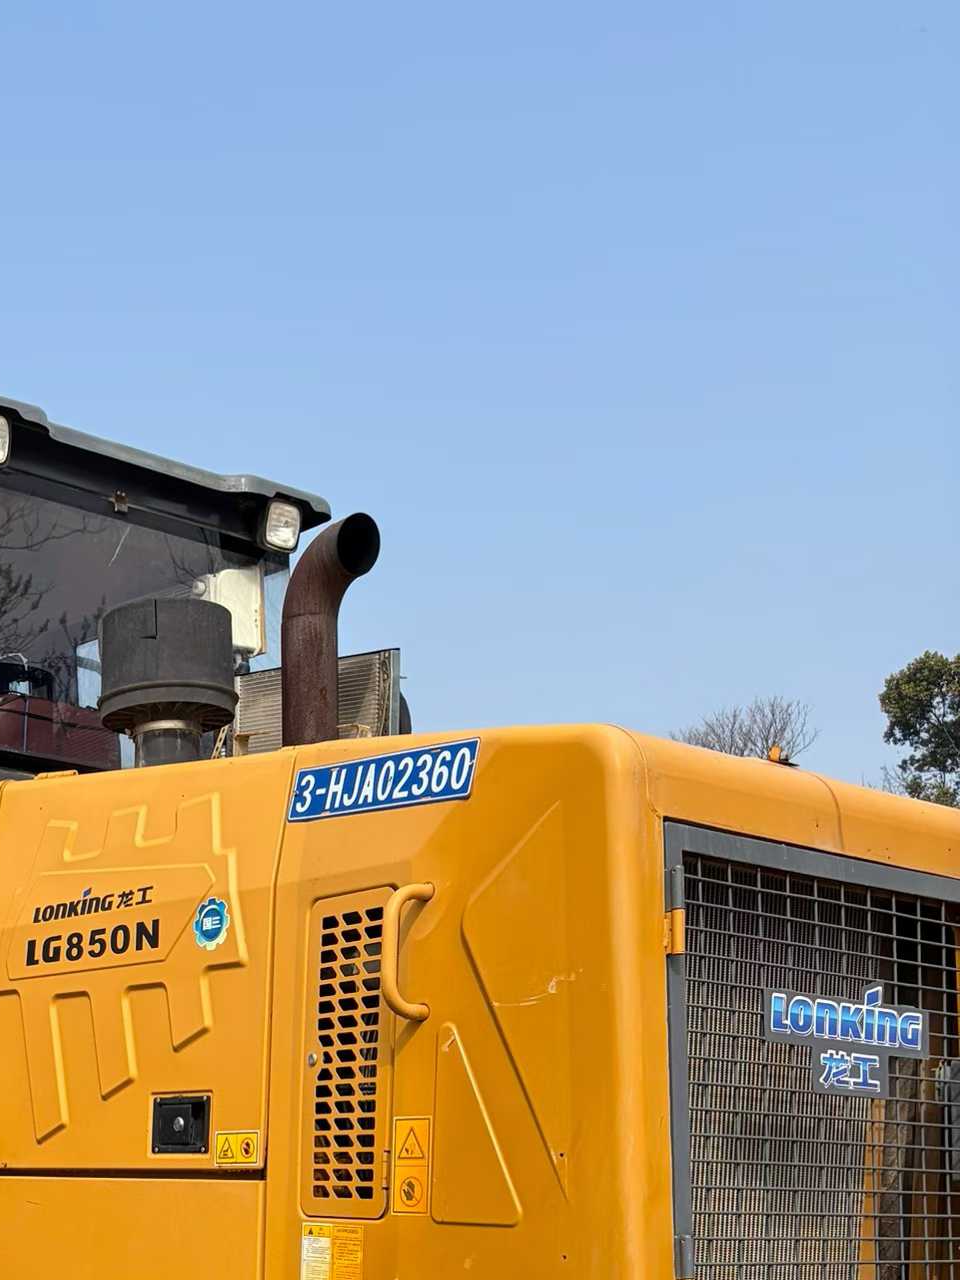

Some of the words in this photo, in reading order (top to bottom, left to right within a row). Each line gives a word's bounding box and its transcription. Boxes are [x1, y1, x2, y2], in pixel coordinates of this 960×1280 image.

[295, 747, 471, 813] 3-HJA02360
[33, 888, 114, 923] LONKING
[116, 886, 154, 909] 龙工
[26, 919, 160, 966] LG850N
[771, 986, 922, 1050] LONKING
[819, 1050, 881, 1092] 龙工
